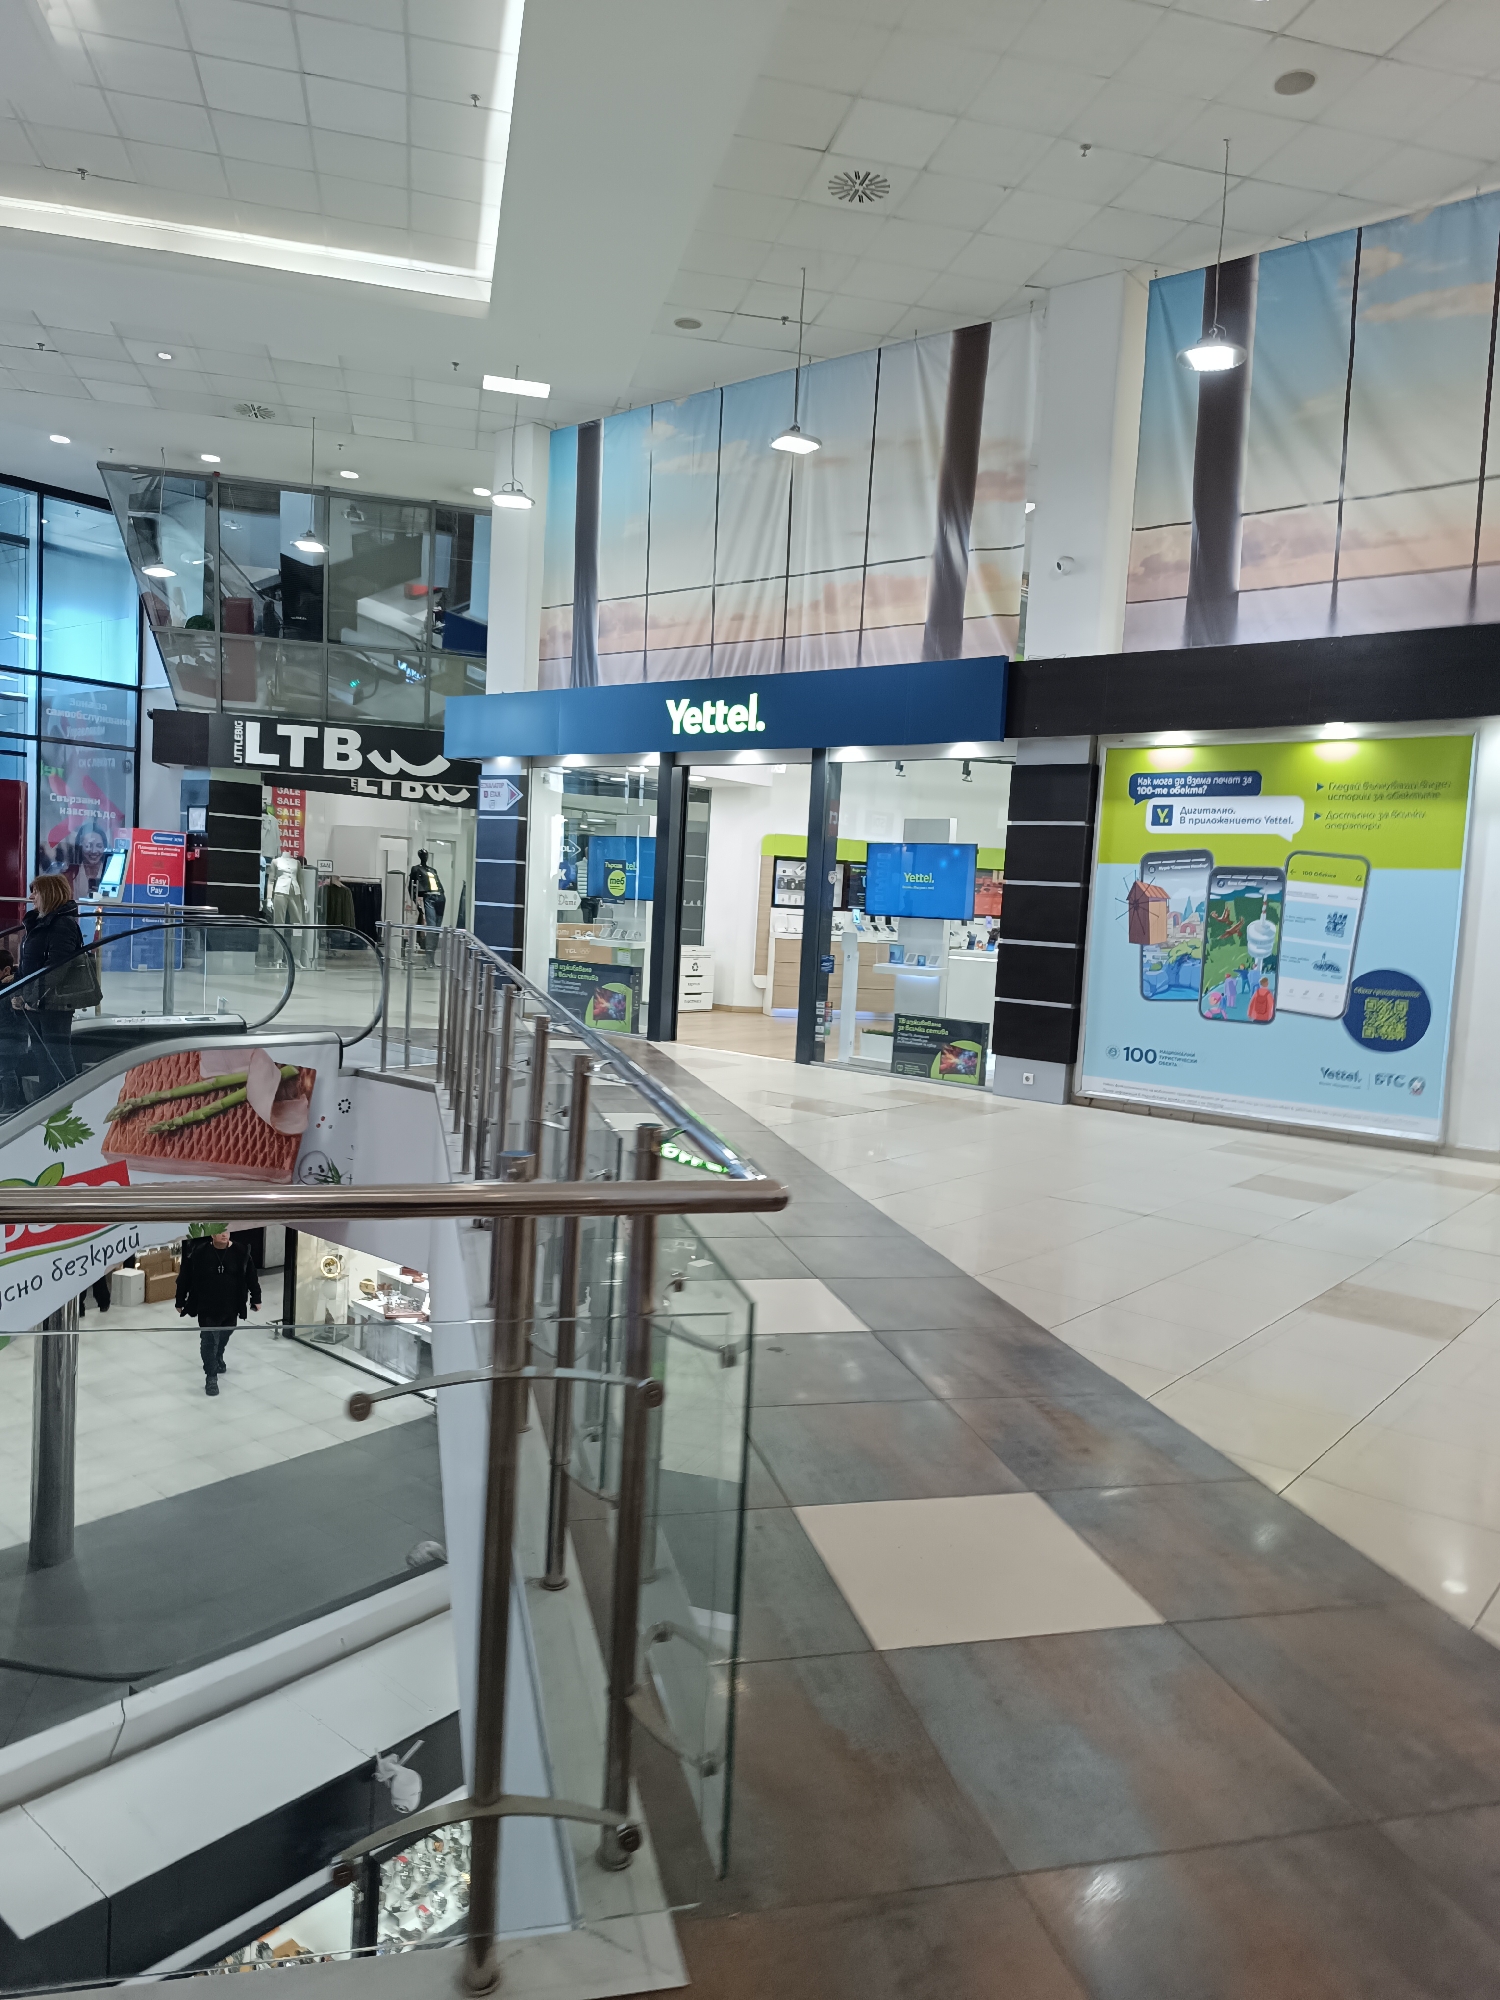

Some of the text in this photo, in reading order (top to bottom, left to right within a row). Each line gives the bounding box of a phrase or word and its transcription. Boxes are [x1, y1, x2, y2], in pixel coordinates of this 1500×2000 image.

[666, 693, 765, 734] Yettel.
[233, 720, 243, 764] LITTLEBIG
[245, 721, 363, 771] LTB
[1138, 776, 1253, 787] Как мога да взема печат за
[277, 787, 300, 796] SALE
[1137, 785, 1208, 795] 100-те обекта?
[49, 793, 101, 806] Свързани
[277, 797, 301, 806] SALE
[59, 807, 116, 820] навсякъде
[277, 807, 301, 817] SALE
[1180, 807, 1236, 816] Дигитално.
[1180, 816, 1294, 826] В приложението Yettel.
[280, 840, 300, 848] ALE
[150, 877, 167, 886] Easy
[904, 872, 935, 884] Yettel.
[150, 886, 163, 895] Pay
[1123, 1046, 1157, 1064] 100
[1320, 1066, 1362, 1083] Yettel.
[1374, 1072, 1406, 1088] БТС
[51, 1225, 140, 1281] безкрай
